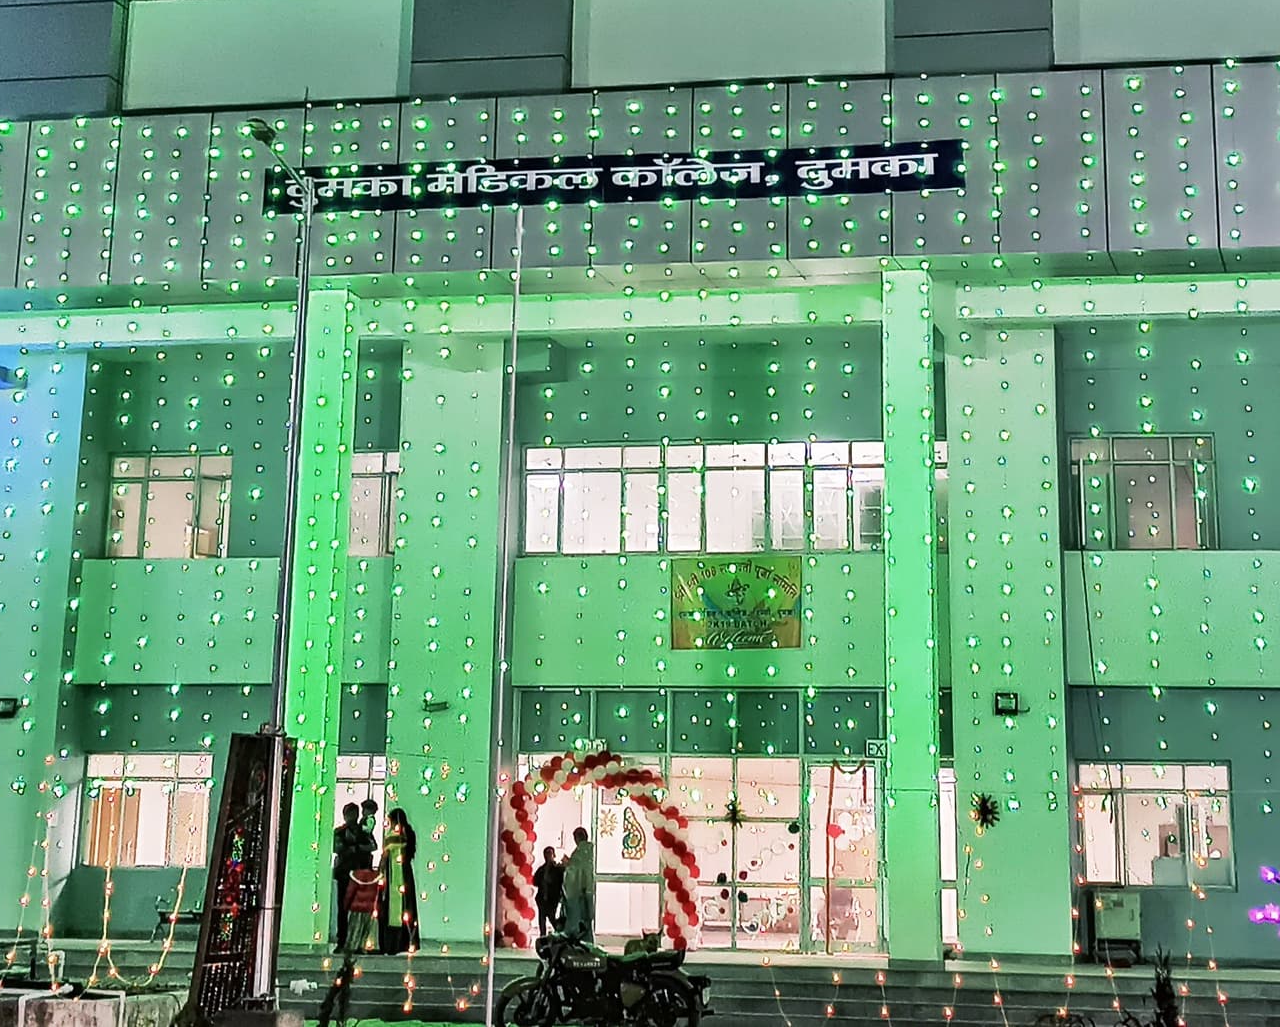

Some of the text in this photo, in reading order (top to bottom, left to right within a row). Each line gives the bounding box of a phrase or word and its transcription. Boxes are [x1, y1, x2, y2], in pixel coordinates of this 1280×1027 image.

[285, 174, 417, 208] दुमका
[426, 164, 604, 194] मेडिकल
[795, 153, 939, 190] दुमका
